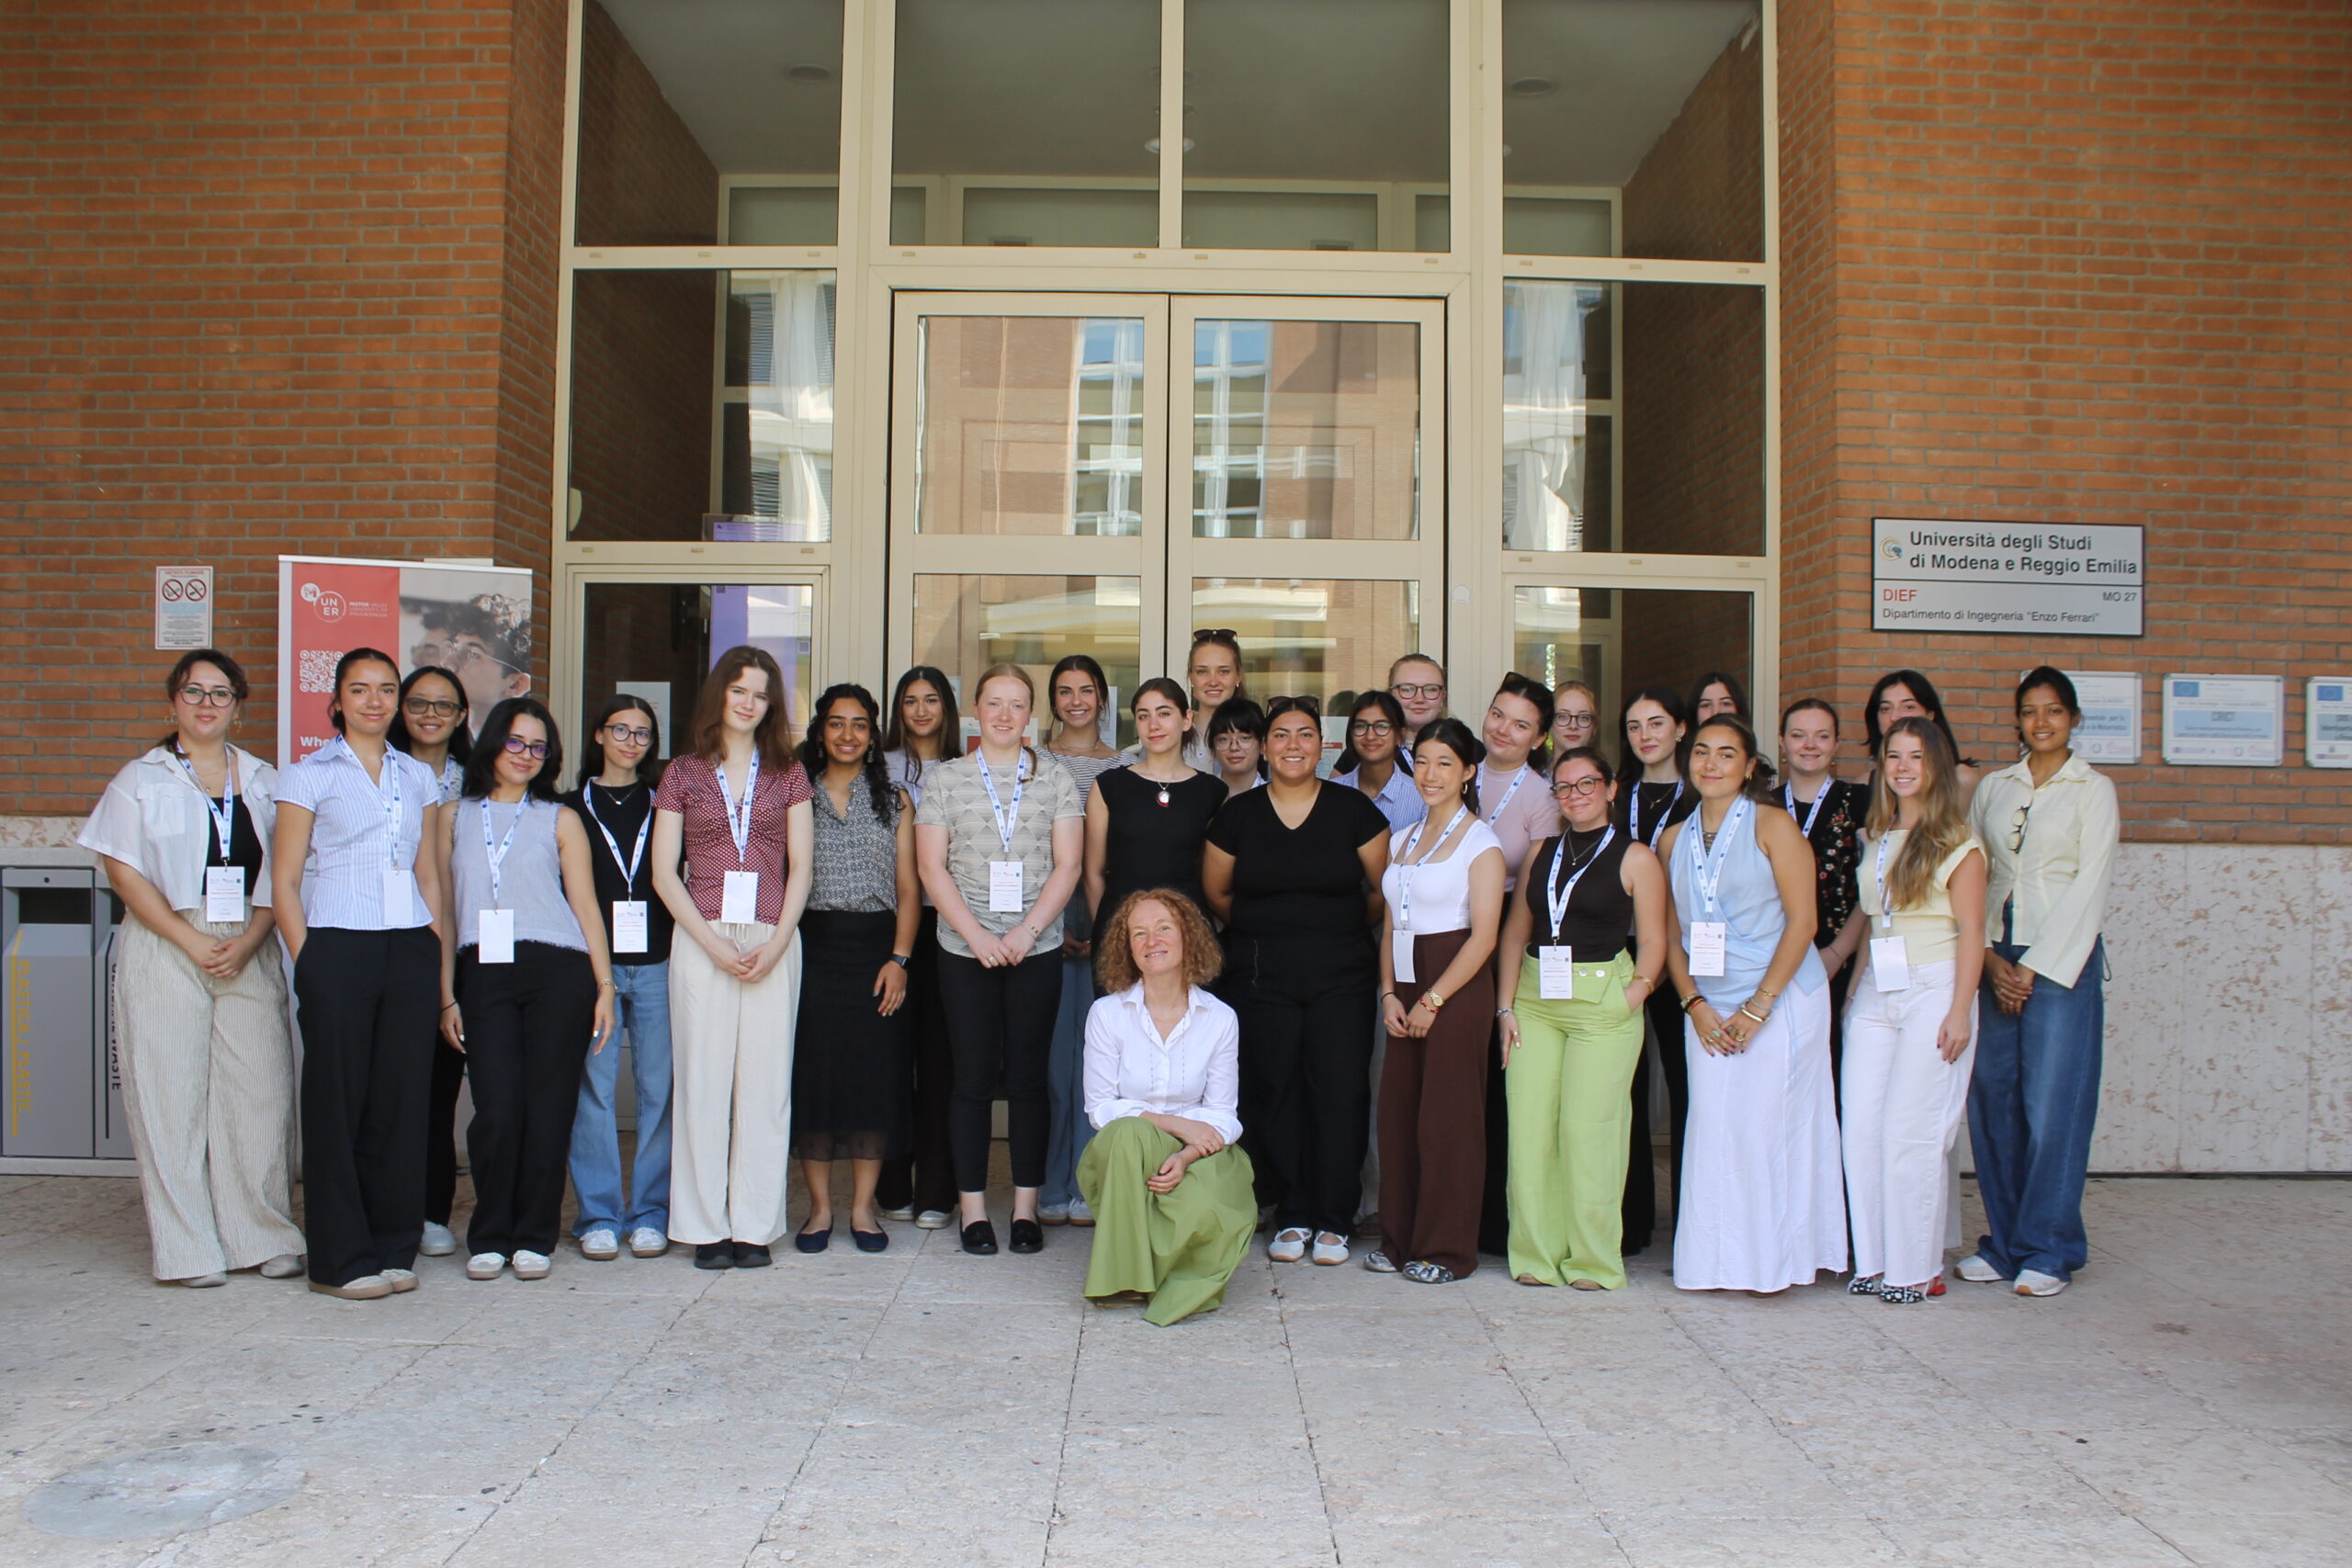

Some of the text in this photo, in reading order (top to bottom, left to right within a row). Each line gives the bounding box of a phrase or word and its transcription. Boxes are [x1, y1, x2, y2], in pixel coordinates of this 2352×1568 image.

[1910, 531, 2092, 552] Università degli Studi
[1910, 554, 2137, 576] di Modena e Reggio Emilia
[320, 598, 338, 606] UN
[1883, 589, 1917, 602] DIEF
[2103, 592, 2137, 602] MO 27
[323, 607, 339, 616] ER
[1883, 608, 1951, 620] Dipartimento
[1954, 610, 1964, 620] di
[1967, 610, 2023, 623] Ingegneria
[18, 961, 30, 1033] PLASTICA
[18, 1051, 31, 1112] PLASTIC
